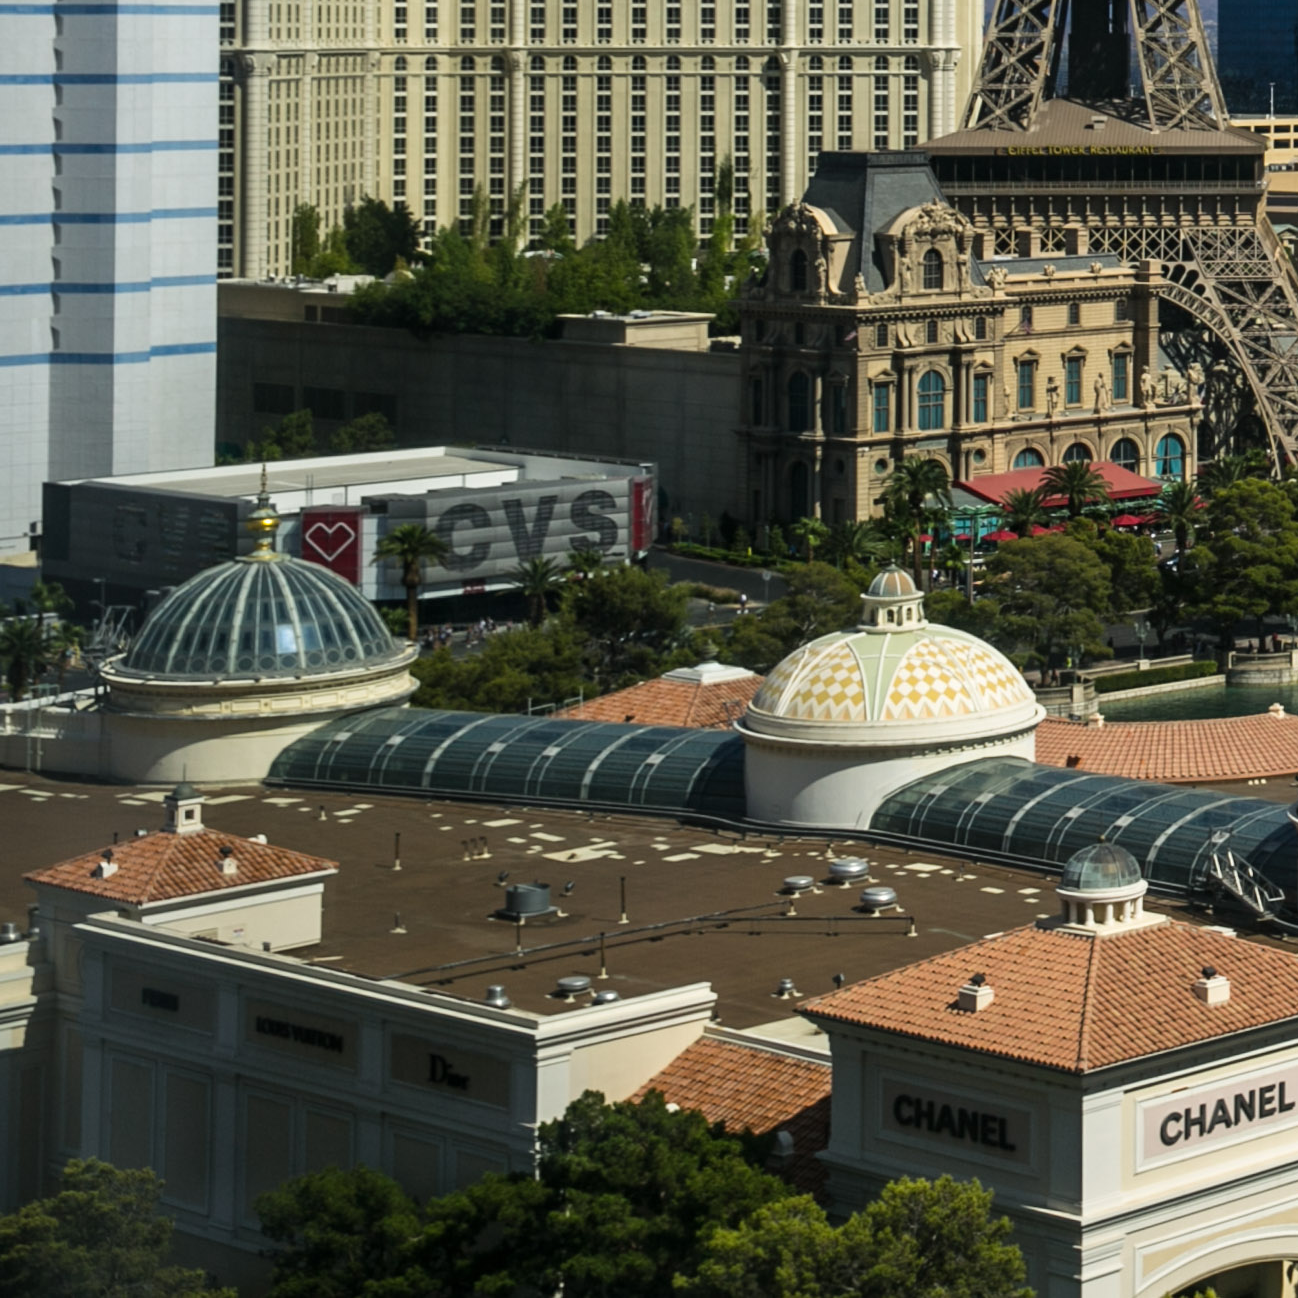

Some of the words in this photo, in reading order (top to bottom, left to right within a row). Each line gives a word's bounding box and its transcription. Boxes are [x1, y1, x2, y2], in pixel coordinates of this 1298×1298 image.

[436, 490, 620, 573] CVS
[893, 1093, 1016, 1151] CHANEL
[1160, 1081, 1295, 1146] CHANEL
